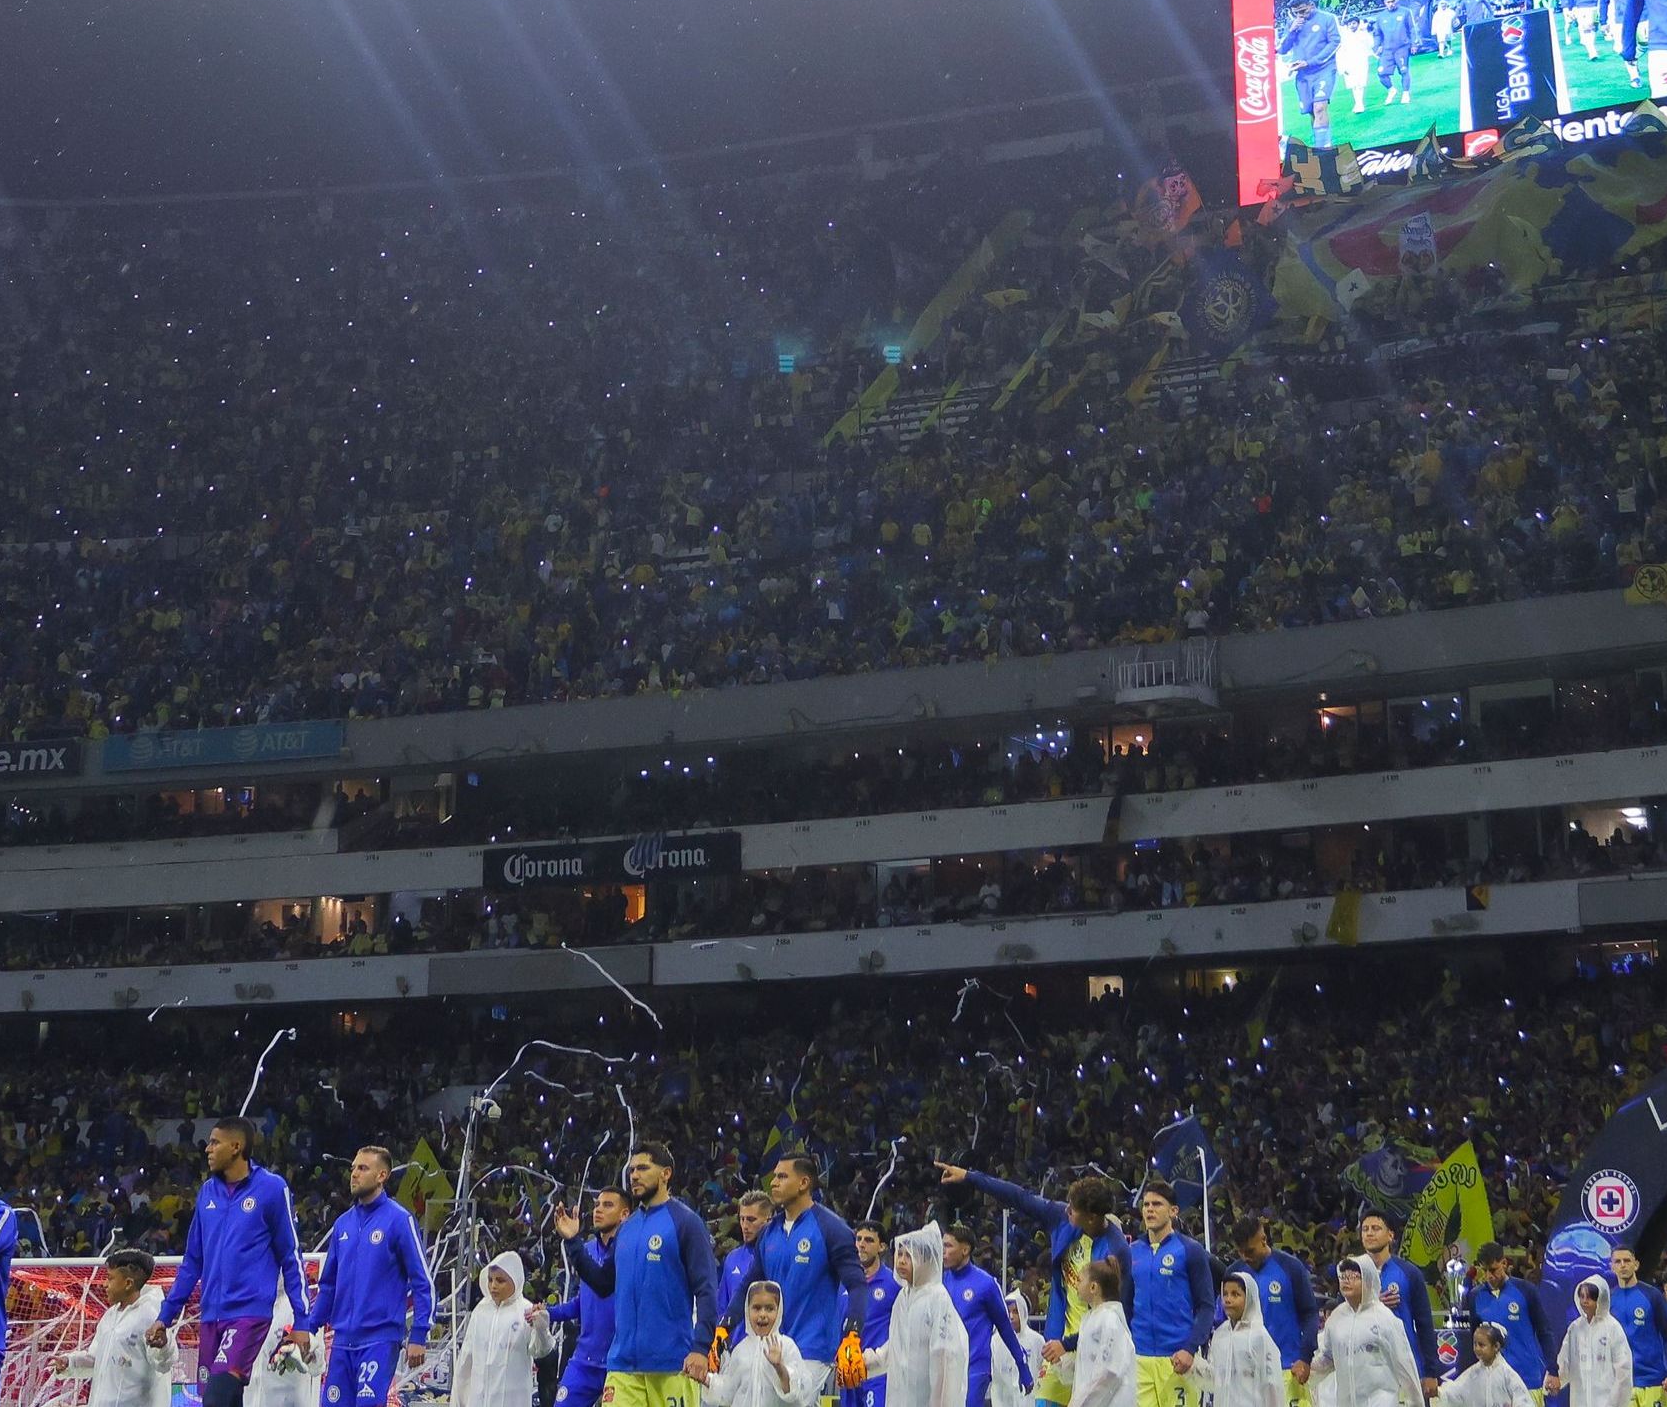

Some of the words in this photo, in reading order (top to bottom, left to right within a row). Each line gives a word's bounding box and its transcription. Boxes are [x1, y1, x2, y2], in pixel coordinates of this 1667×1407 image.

[1237, 36, 1271, 116] Coca-Cola
[1504, 44, 1531, 103] BBVA
[1496, 87, 1511, 120] LIGA
[260, 730, 309, 752] AT&T
[504, 853, 583, 887] Corona
[358, 1360, 379, 1383] 29
